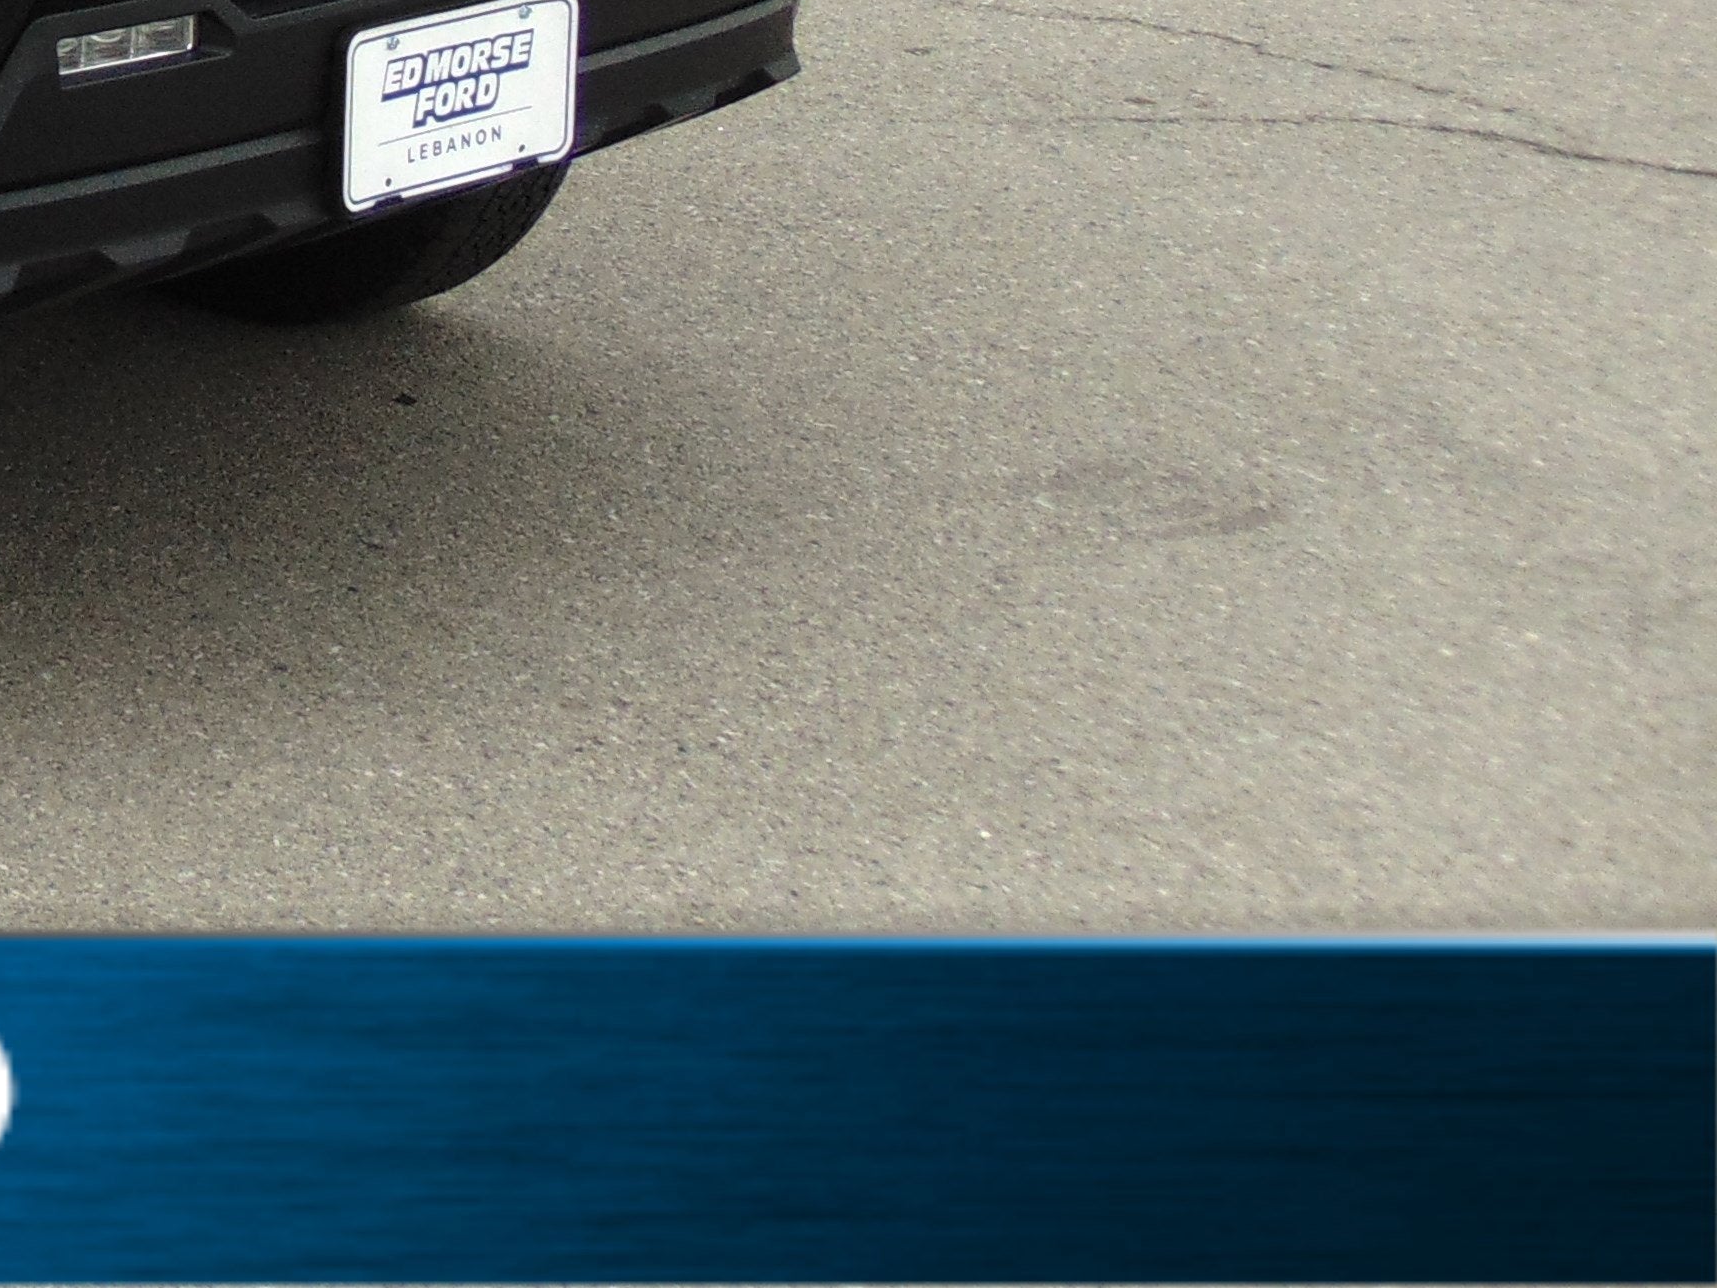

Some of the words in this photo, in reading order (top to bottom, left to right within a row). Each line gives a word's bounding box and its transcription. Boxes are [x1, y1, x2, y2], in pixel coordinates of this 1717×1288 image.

[381, 53, 425, 102] ED
[423, 28, 534, 86] MORSE
[412, 71, 500, 129] FORD
[407, 125, 502, 164] LEBANON
